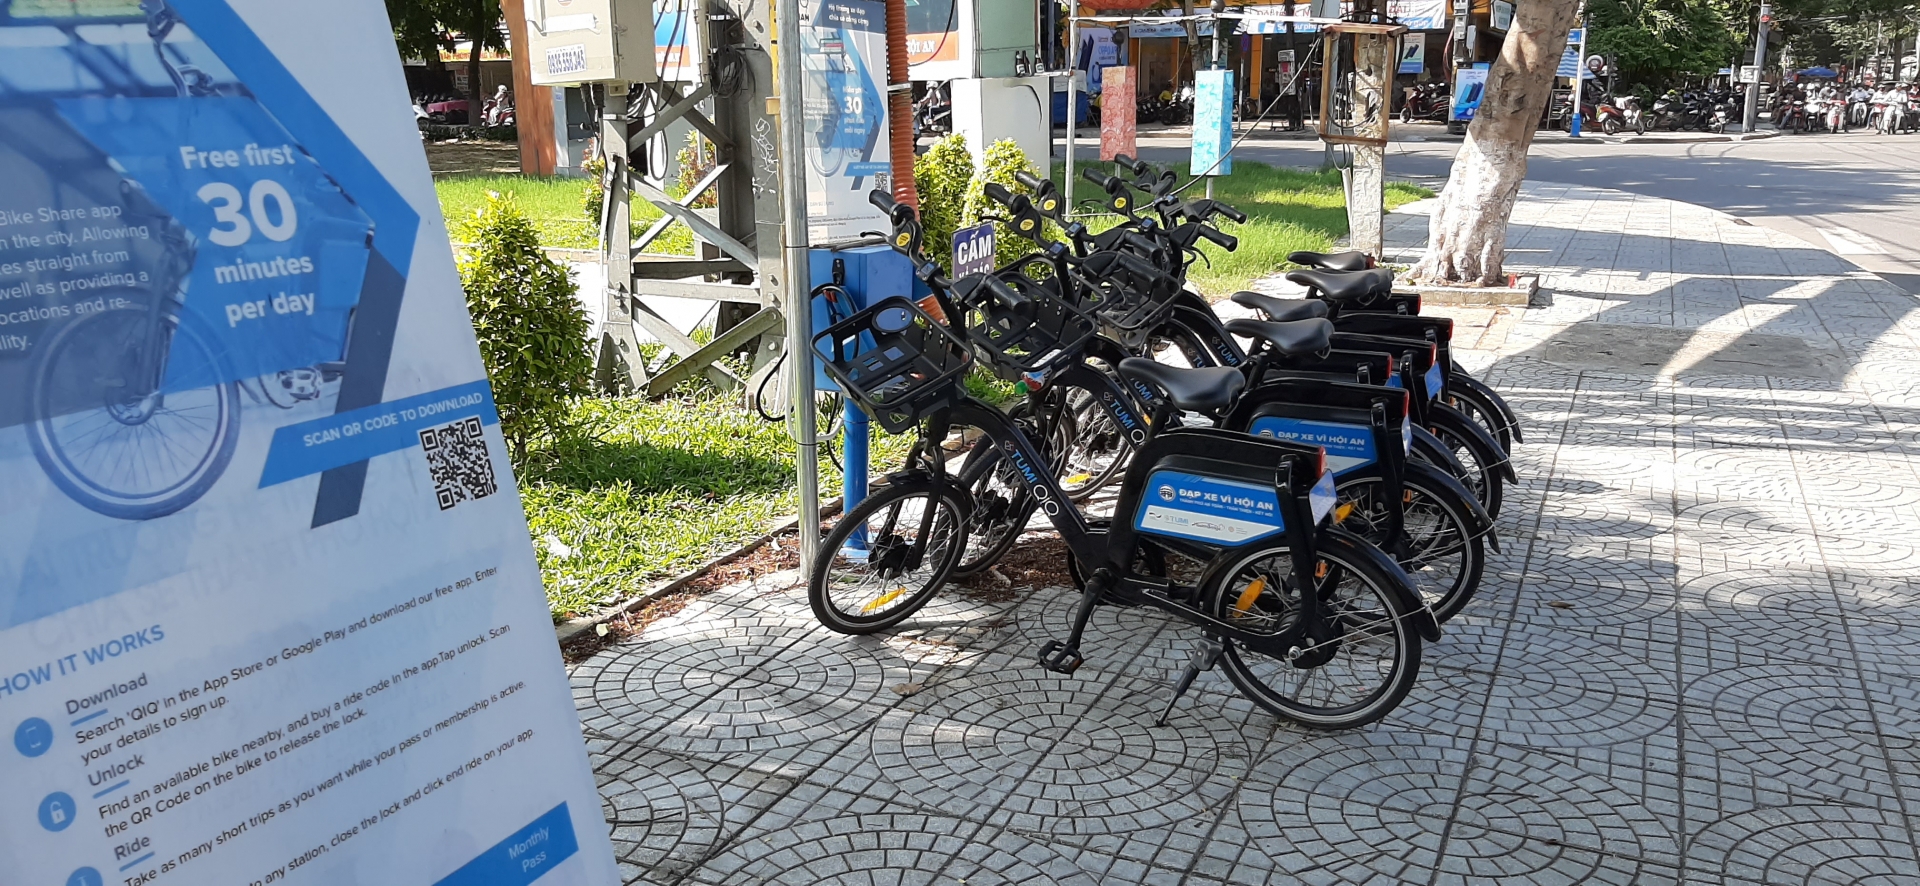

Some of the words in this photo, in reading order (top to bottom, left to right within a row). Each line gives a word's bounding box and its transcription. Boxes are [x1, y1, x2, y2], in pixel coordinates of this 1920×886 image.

[844, 96, 862, 114] 30
[179, 145, 240, 169] Free
[243, 143, 295, 166] first
[37, 207, 86, 222] Share
[91, 205, 122, 219] app
[196, 179, 297, 247] 30
[12, 234, 40, 249] the
[46, 231, 78, 247] city.
[82, 225, 149, 242] Allowing
[958, 230, 991, 265] CẤM
[26, 252, 90, 272] straight
[91, 250, 129, 265] from
[214, 255, 314, 284] minutes
[36, 283, 55, 295] as
[60, 272, 136, 295] providing
[139, 271, 149, 282] a
[75, 297, 105, 315] and
[225, 299, 266, 328] per
[272, 291, 315, 316] day
[1217, 342, 1238, 366] TUMI
[1130, 378, 1153, 400] UMI
[303, 427, 340, 447] SCAN
[342, 422, 362, 437] QR
[364, 413, 398, 431] CODE
[399, 409, 416, 422] TO
[418, 392, 483, 418] DOWNLOAD
[1110, 399, 1136, 429] TUMI
[1301, 433, 1314, 441] XE
[1350, 438, 1365, 446] AN
[1011, 449, 1038, 484] TUMI
[1178, 488, 1200, 499] ĐẠP
[1203, 492, 1218, 501] XE
[1220, 494, 1231, 503] VÌ
[1233, 496, 1254, 508] HỘI
[1256, 502, 1273, 511] AN
[57, 653, 77, 677] IT
[83, 624, 165, 666] WORKS
[75, 717, 125, 744] Search
[163, 695, 177, 709] in
[179, 686, 200, 703] the
[203, 675, 229, 693] App
[230, 661, 263, 681] Store
[266, 655, 278, 667] or
[281, 637, 322, 662] Google
[323, 628, 347, 645] Play
[349, 618, 368, 634] and
[369, 597, 417, 625] download
[419, 592, 434, 605] our
[435, 584, 454, 598] free
[455, 577, 474, 593] app.
[475, 566, 498, 582] Enter
[65, 673, 148, 715] Download
[81, 742, 112, 766] your
[116, 724, 162, 749] details
[163, 716, 177, 728] to
[180, 703, 207, 724] sign
[209, 695, 230, 712] up.
[98, 799, 131, 820] Find
[133, 788, 150, 804] an
[153, 761, 210, 794] available
[212, 747, 239, 767] bike
[241, 728, 286, 753] nearby,
[287, 714, 309, 732] and
[311, 705, 332, 722] buy
[334, 702, 341, 711] a
[342, 691, 363, 707] ride
[365, 678, 390, 696] code
[392, 673, 402, 685] in
[402, 665, 420, 679] the
[457, 633, 488, 654] unlock.
[489, 623, 511, 638] Scan
[88, 753, 145, 787] Unlock
[104, 819, 129, 838] the
[130, 807, 153, 825] QR
[155, 789, 192, 813] Code
[194, 781, 211, 796] on
[214, 770, 234, 787] the
[236, 756, 263, 775] bike
[264, 749, 278, 762] to
[279, 728, 321, 755] release
[323, 721, 340, 734] the
[341, 708, 368, 726] lock.
[160, 859, 177, 874] as
[178, 839, 213, 867] many
[215, 822, 248, 846] short
[249, 808, 276, 829] trips
[278, 798, 292, 813] as
[293, 788, 316, 807] you
[316, 772, 344, 793] want
[345, 757, 373, 779] while
[374, 746, 397, 766] your
[399, 732, 422, 754] pass
[422, 727, 433, 738] or
[435, 698, 489, 732] membership
[490, 693, 498, 703] is
[499, 680, 527, 699] active.
[264, 867, 286, 884] any
[288, 842, 330, 871] station,
[330, 824, 359, 848] close
[360, 814, 378, 830] the
[380, 801, 401, 822] lock
[402, 789, 422, 807] and
[423, 777, 444, 796] click
[445, 766, 464, 783] end
[465, 756, 483, 771] ride
[484, 750, 496, 762] on
[496, 737, 516, 755] your
[517, 728, 536, 744] app.
[113, 834, 151, 861] Ride
[508, 826, 550, 859] Monthly
[521, 850, 547, 872] Pass
